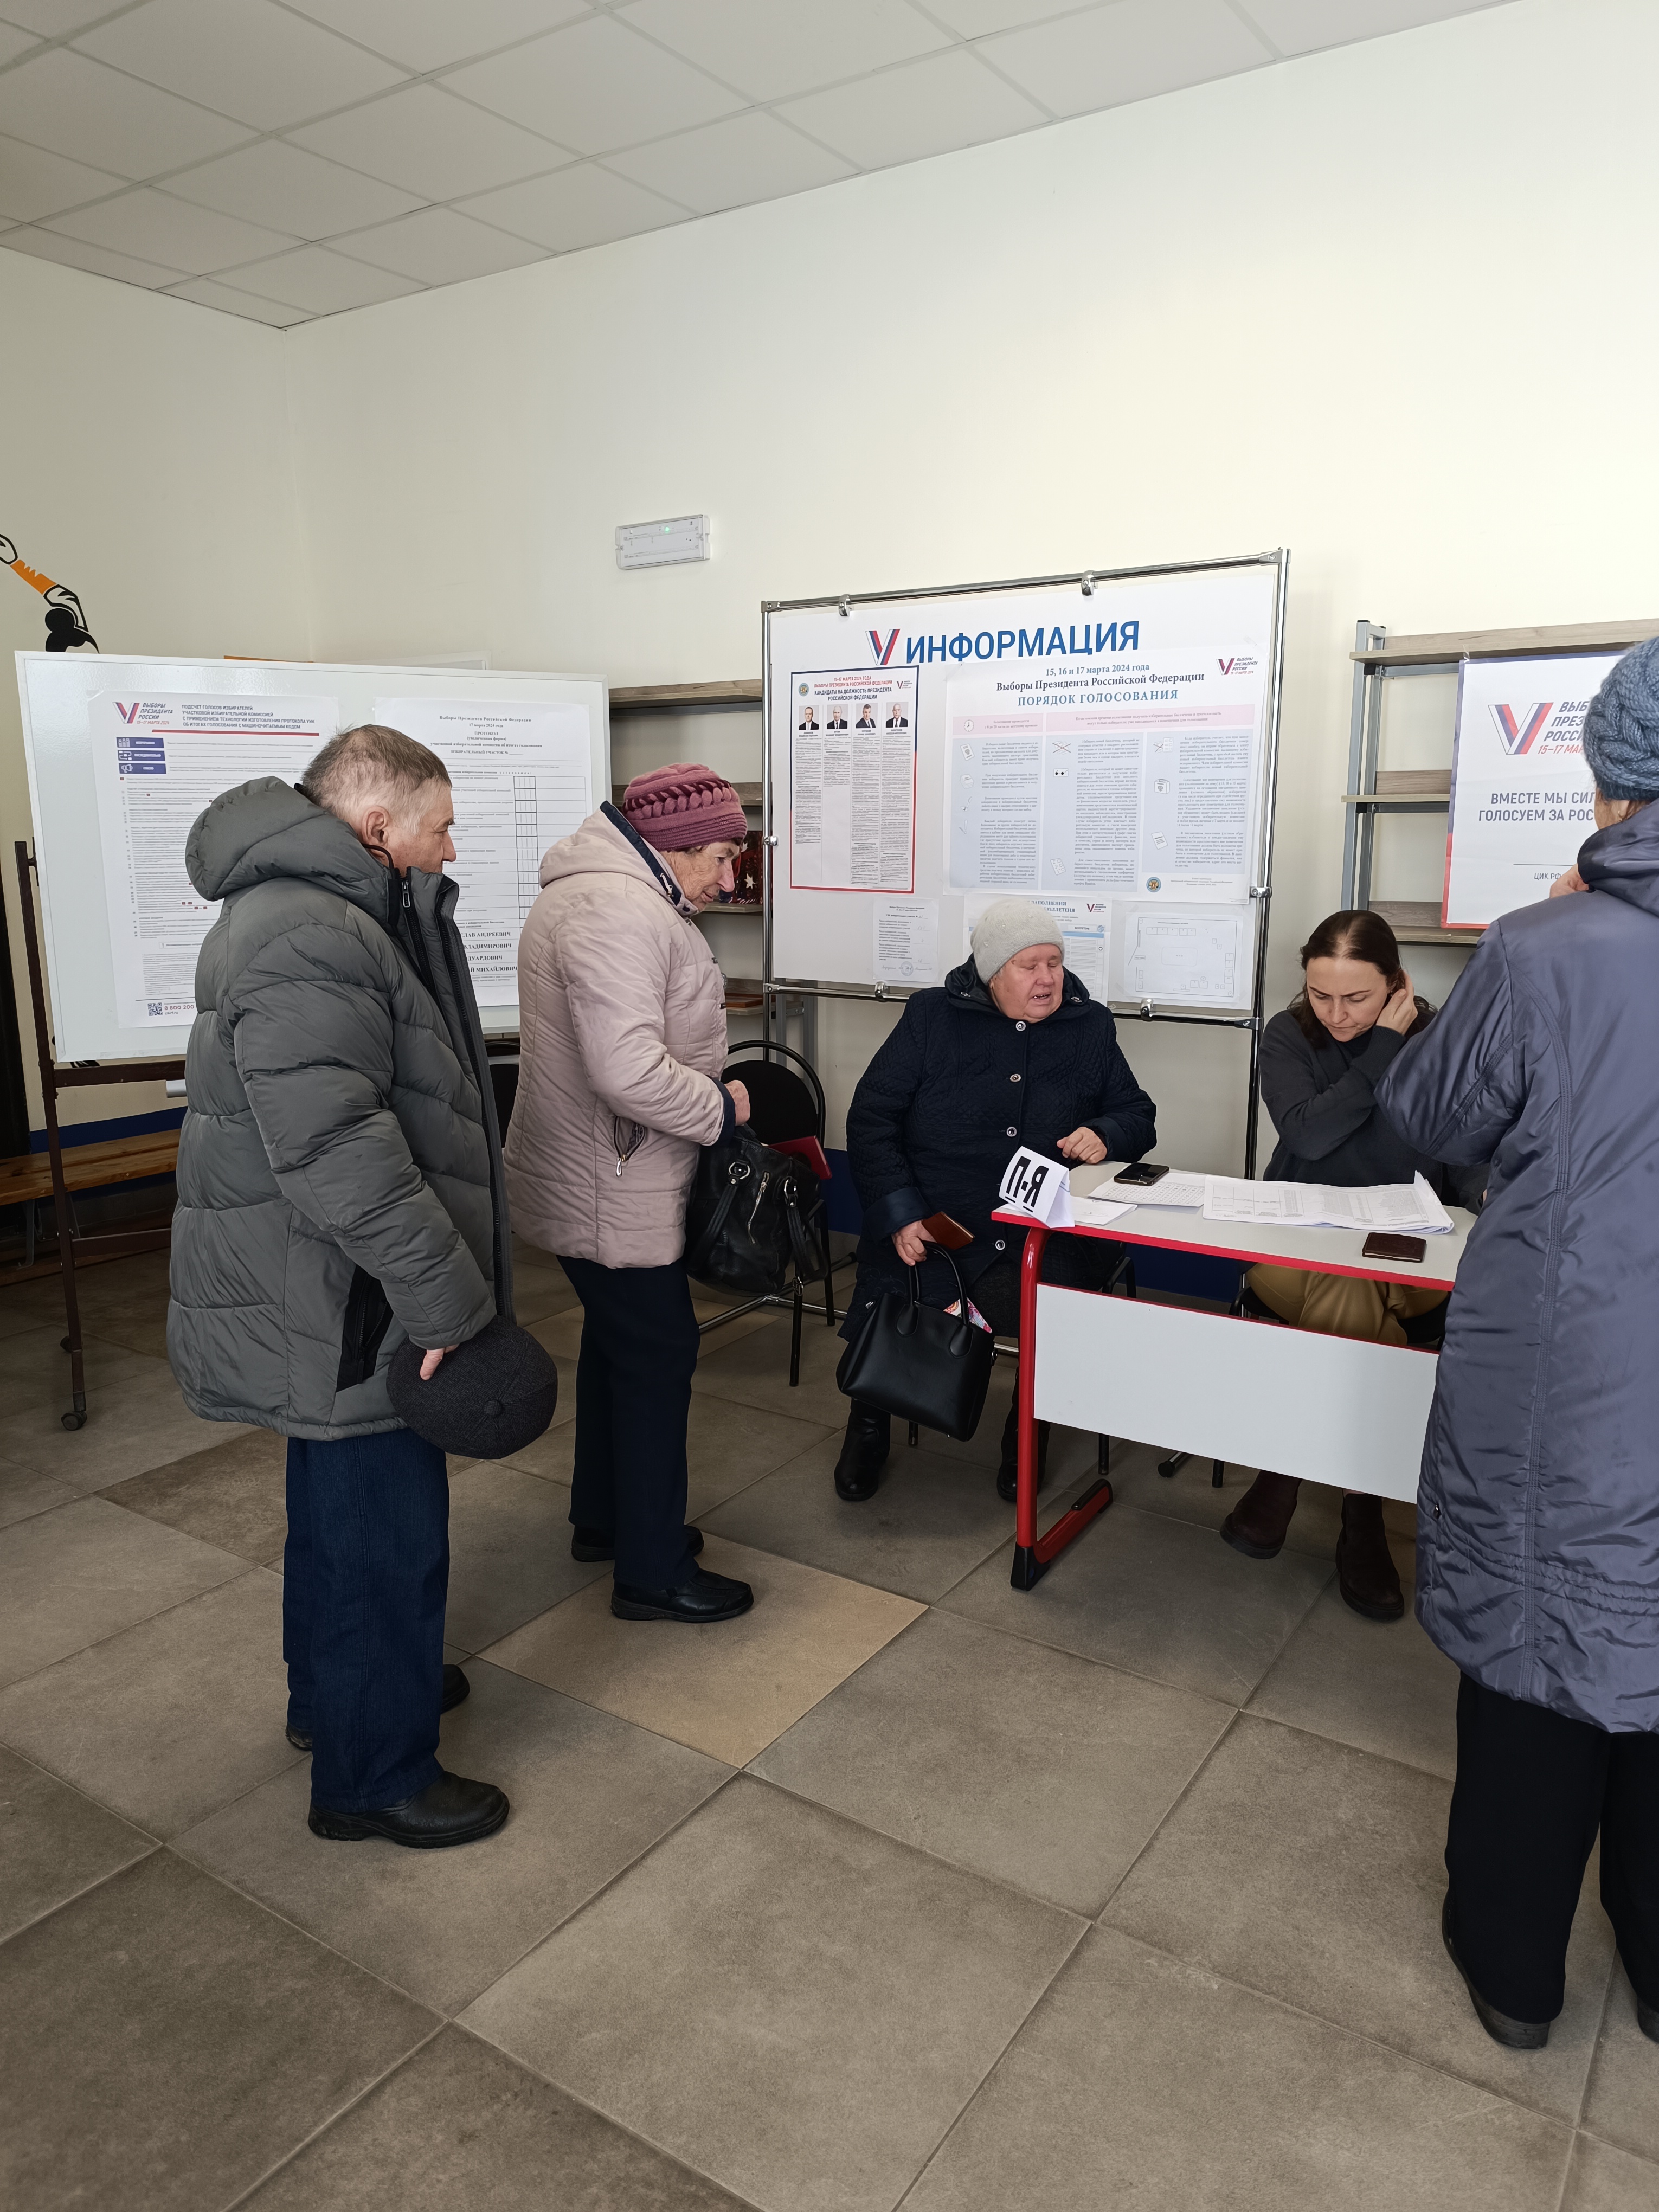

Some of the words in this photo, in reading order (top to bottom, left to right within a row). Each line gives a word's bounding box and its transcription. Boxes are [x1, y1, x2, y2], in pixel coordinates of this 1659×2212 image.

[906, 620, 1139, 664] ИНФОРМАЦИЯ
[1086, 667, 1110, 675] марта
[1111, 664, 1130, 672] 2024
[996, 681, 1032, 692] Выборы
[1035, 680, 1089, 691] Президента
[1091, 675, 1146, 686] Российской
[1149, 673, 1204, 684] Федерации
[1018, 694, 1076, 706] ПОРЯДОК
[1080, 690, 1178, 703] ГОЛОСОВАНИЯ
[1491, 793, 1540, 804] ВМЕСТЕ
[1545, 793, 1567, 803] МЫ
[1479, 809, 1545, 821] ГОЛОСУЕМ
[1549, 809, 1564, 821] ЗА
